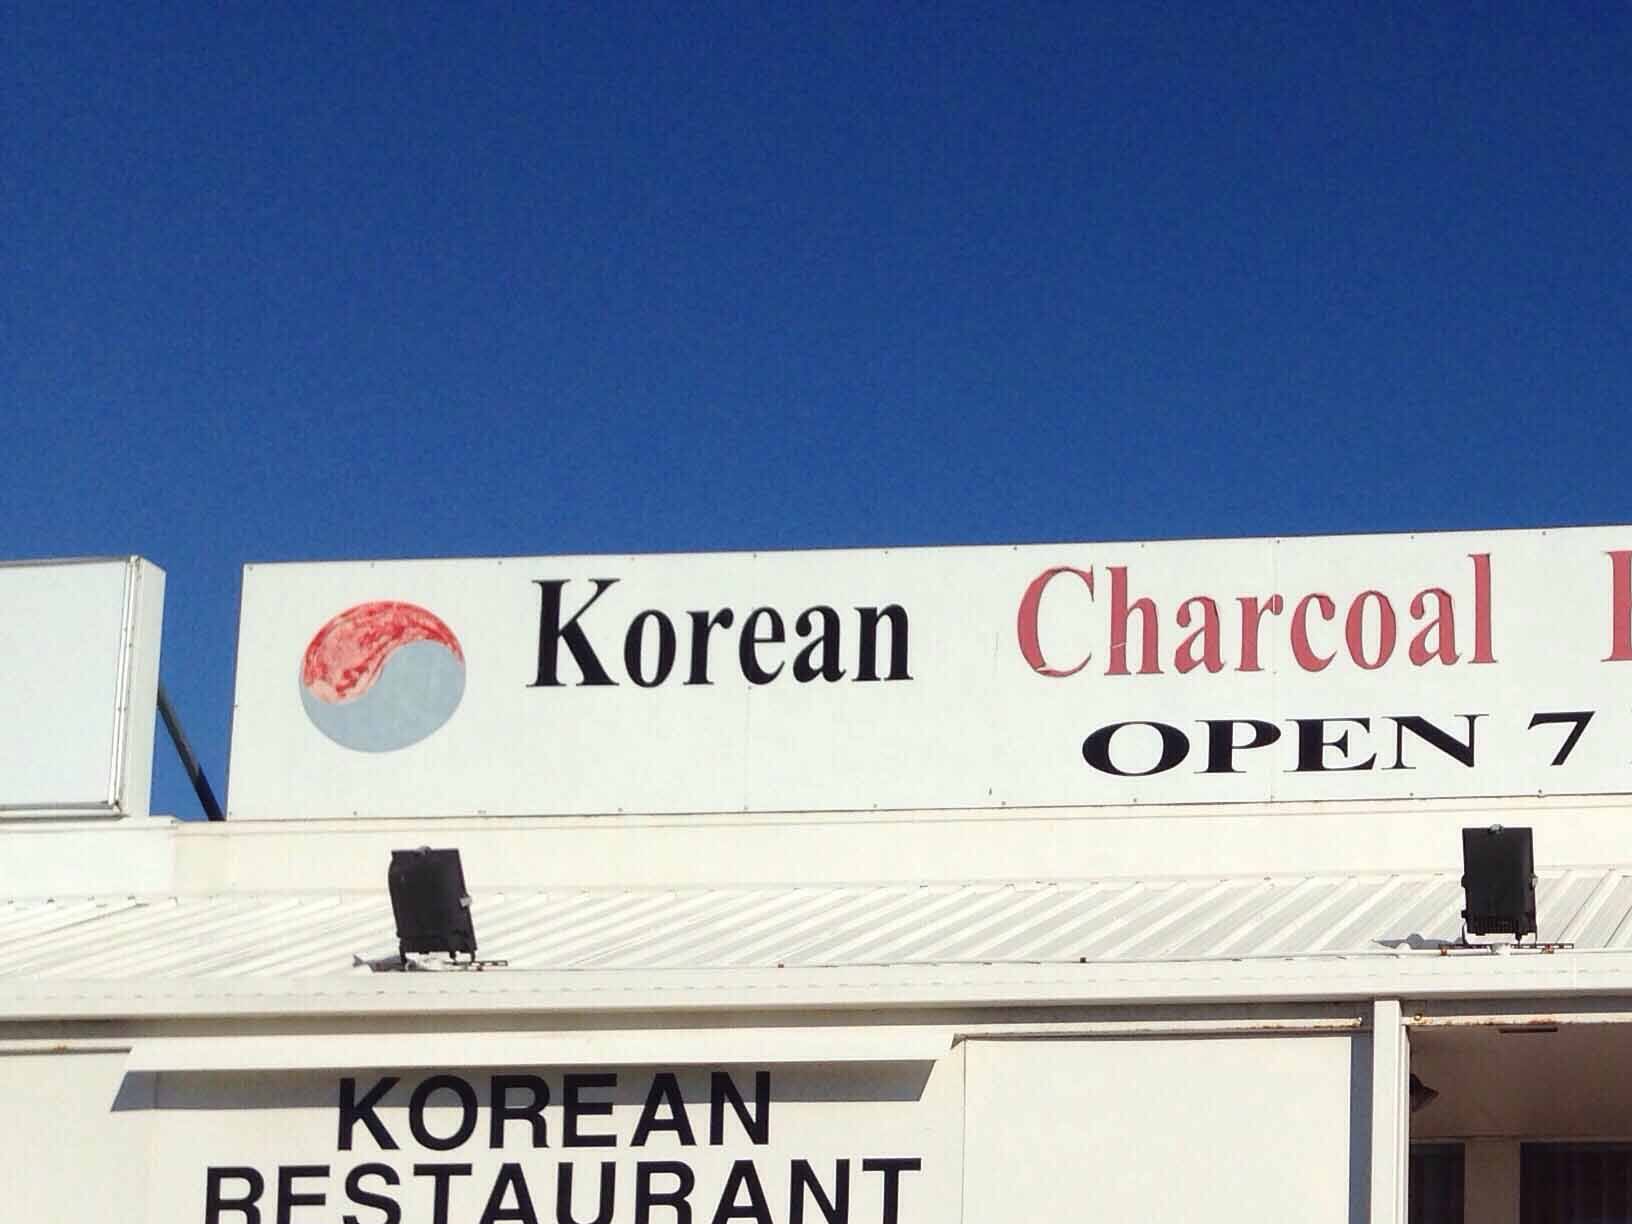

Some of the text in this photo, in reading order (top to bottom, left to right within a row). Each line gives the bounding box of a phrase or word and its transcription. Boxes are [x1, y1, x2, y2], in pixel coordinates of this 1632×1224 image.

[531, 580, 913, 687] Korean
[1018, 554, 1496, 677] Charcoal
[1083, 715, 1478, 776] OPEN
[1528, 712, 1594, 765] 7
[338, 1071, 771, 1151] KOREAN
